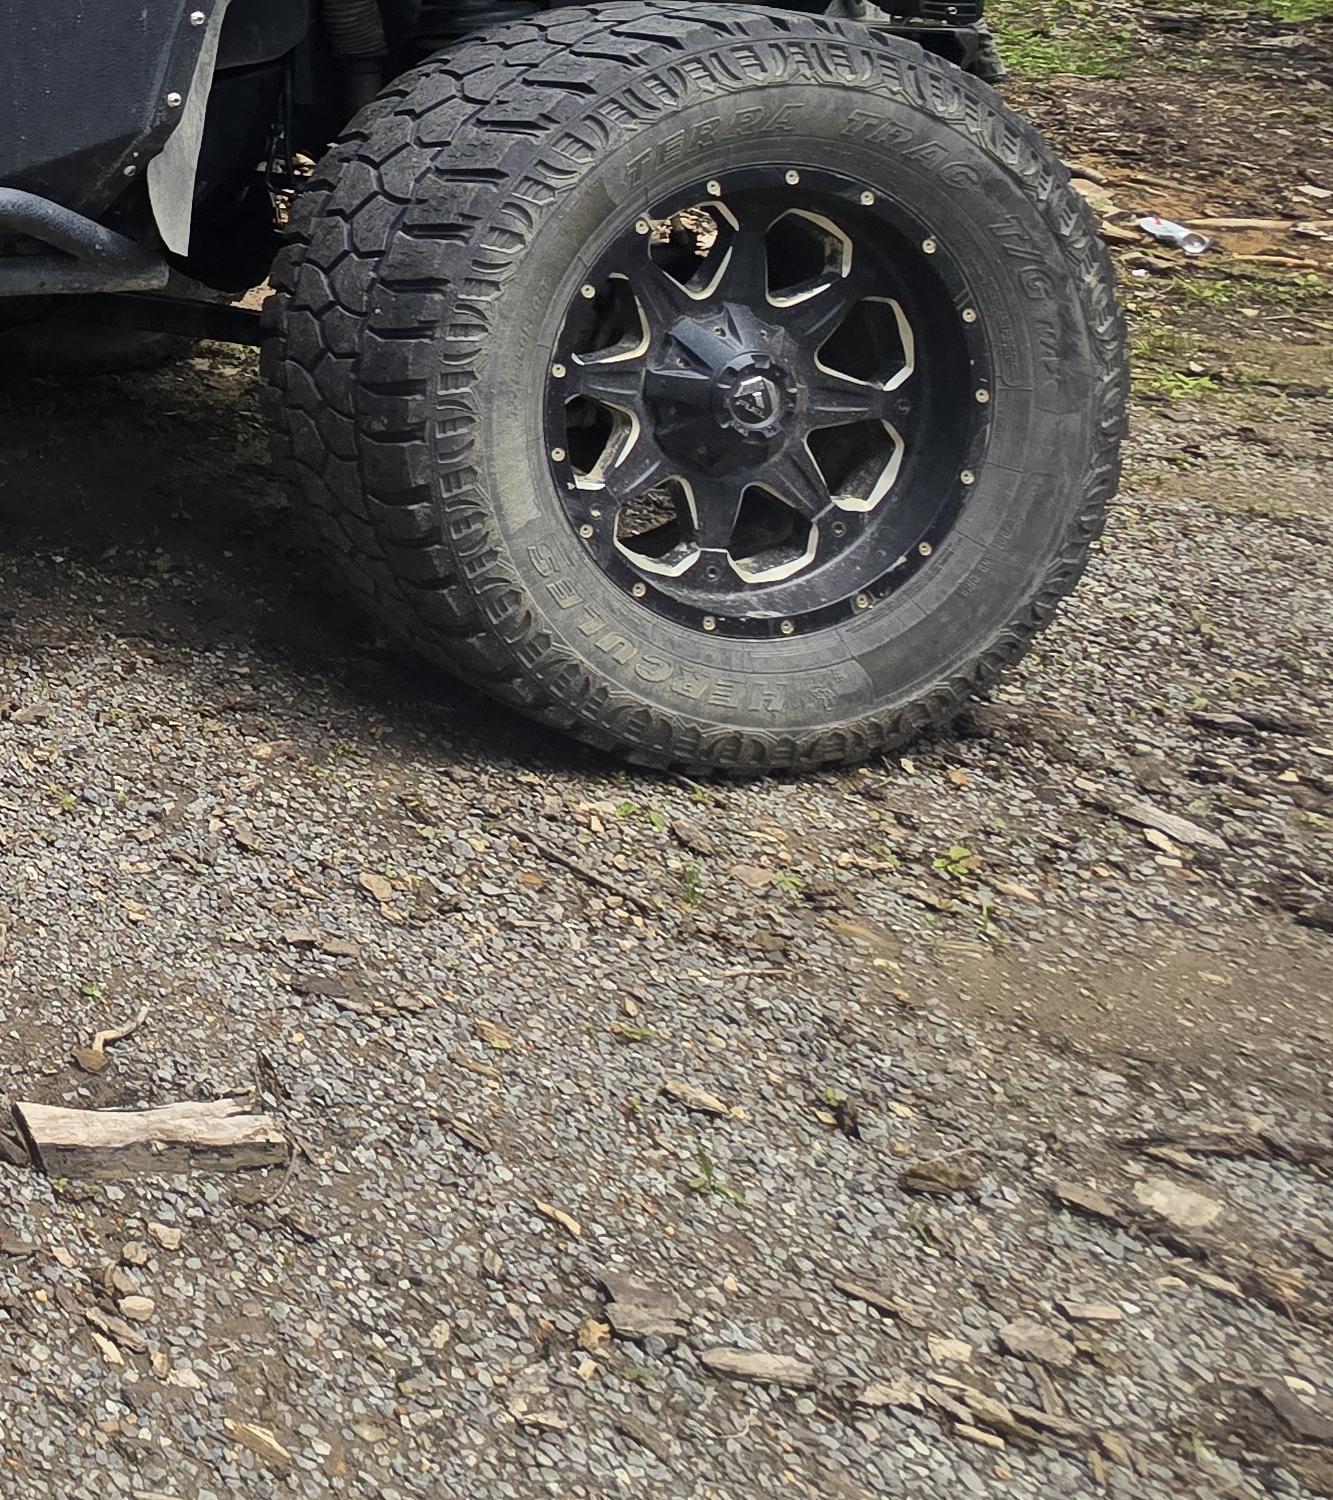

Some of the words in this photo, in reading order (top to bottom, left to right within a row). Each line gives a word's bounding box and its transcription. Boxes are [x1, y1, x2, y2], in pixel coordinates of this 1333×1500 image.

[625, 102, 805, 187] TERRA
[838, 106, 983, 192] TRAC
[988, 213, 1056, 301] T/G
[527, 536, 789, 712] HERCULES
